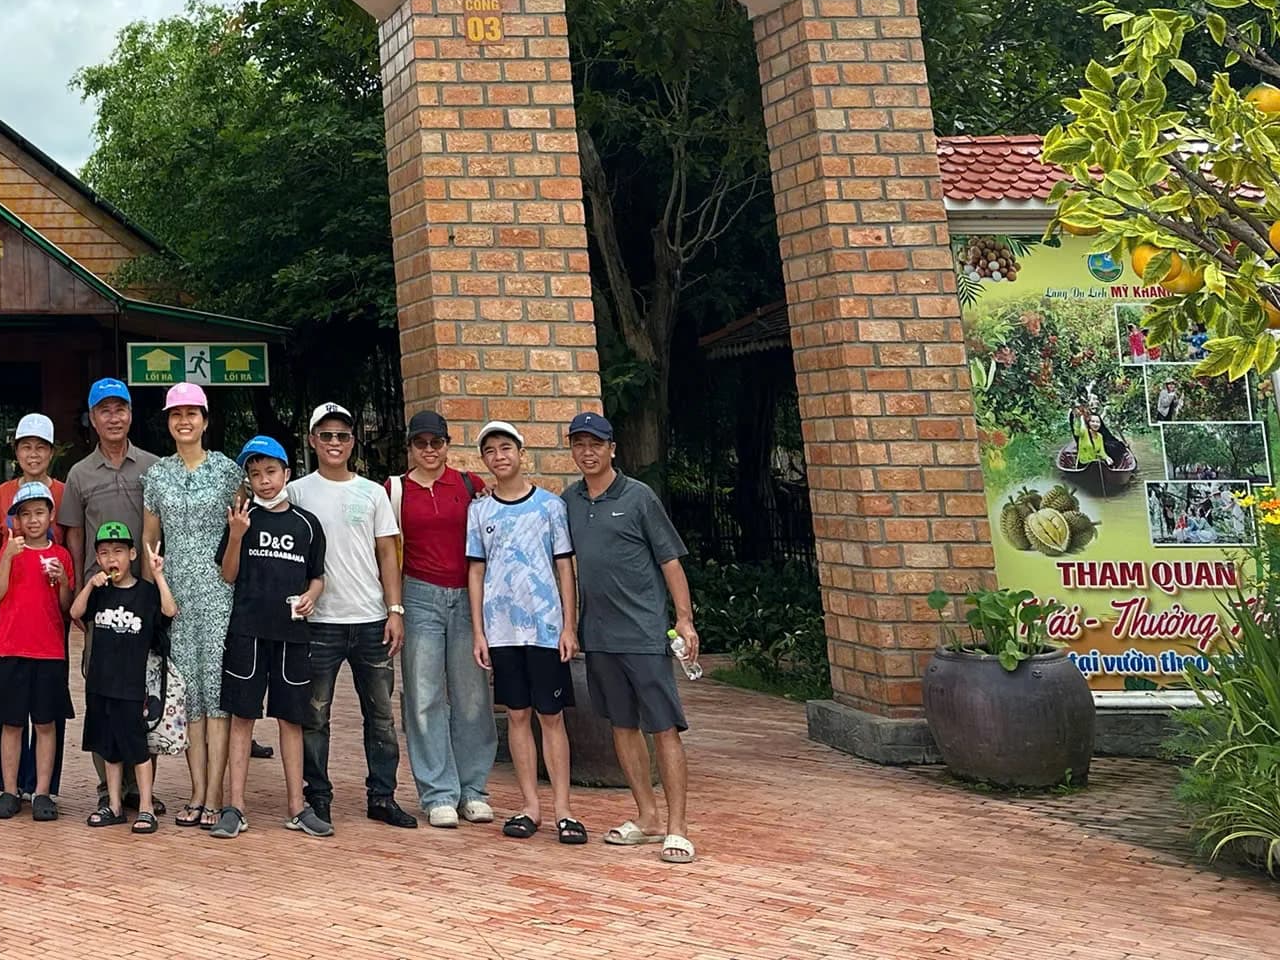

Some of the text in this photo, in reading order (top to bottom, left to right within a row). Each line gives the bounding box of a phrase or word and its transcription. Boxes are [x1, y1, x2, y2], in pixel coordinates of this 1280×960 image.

[467, 16, 501, 41] 03
[259, 531, 295, 551] D&G
[1056, 561, 1238, 592] THAM QUAN
[1111, 597, 1219, 649] Thưởng
[1104, 651, 1157, 673] vườn
